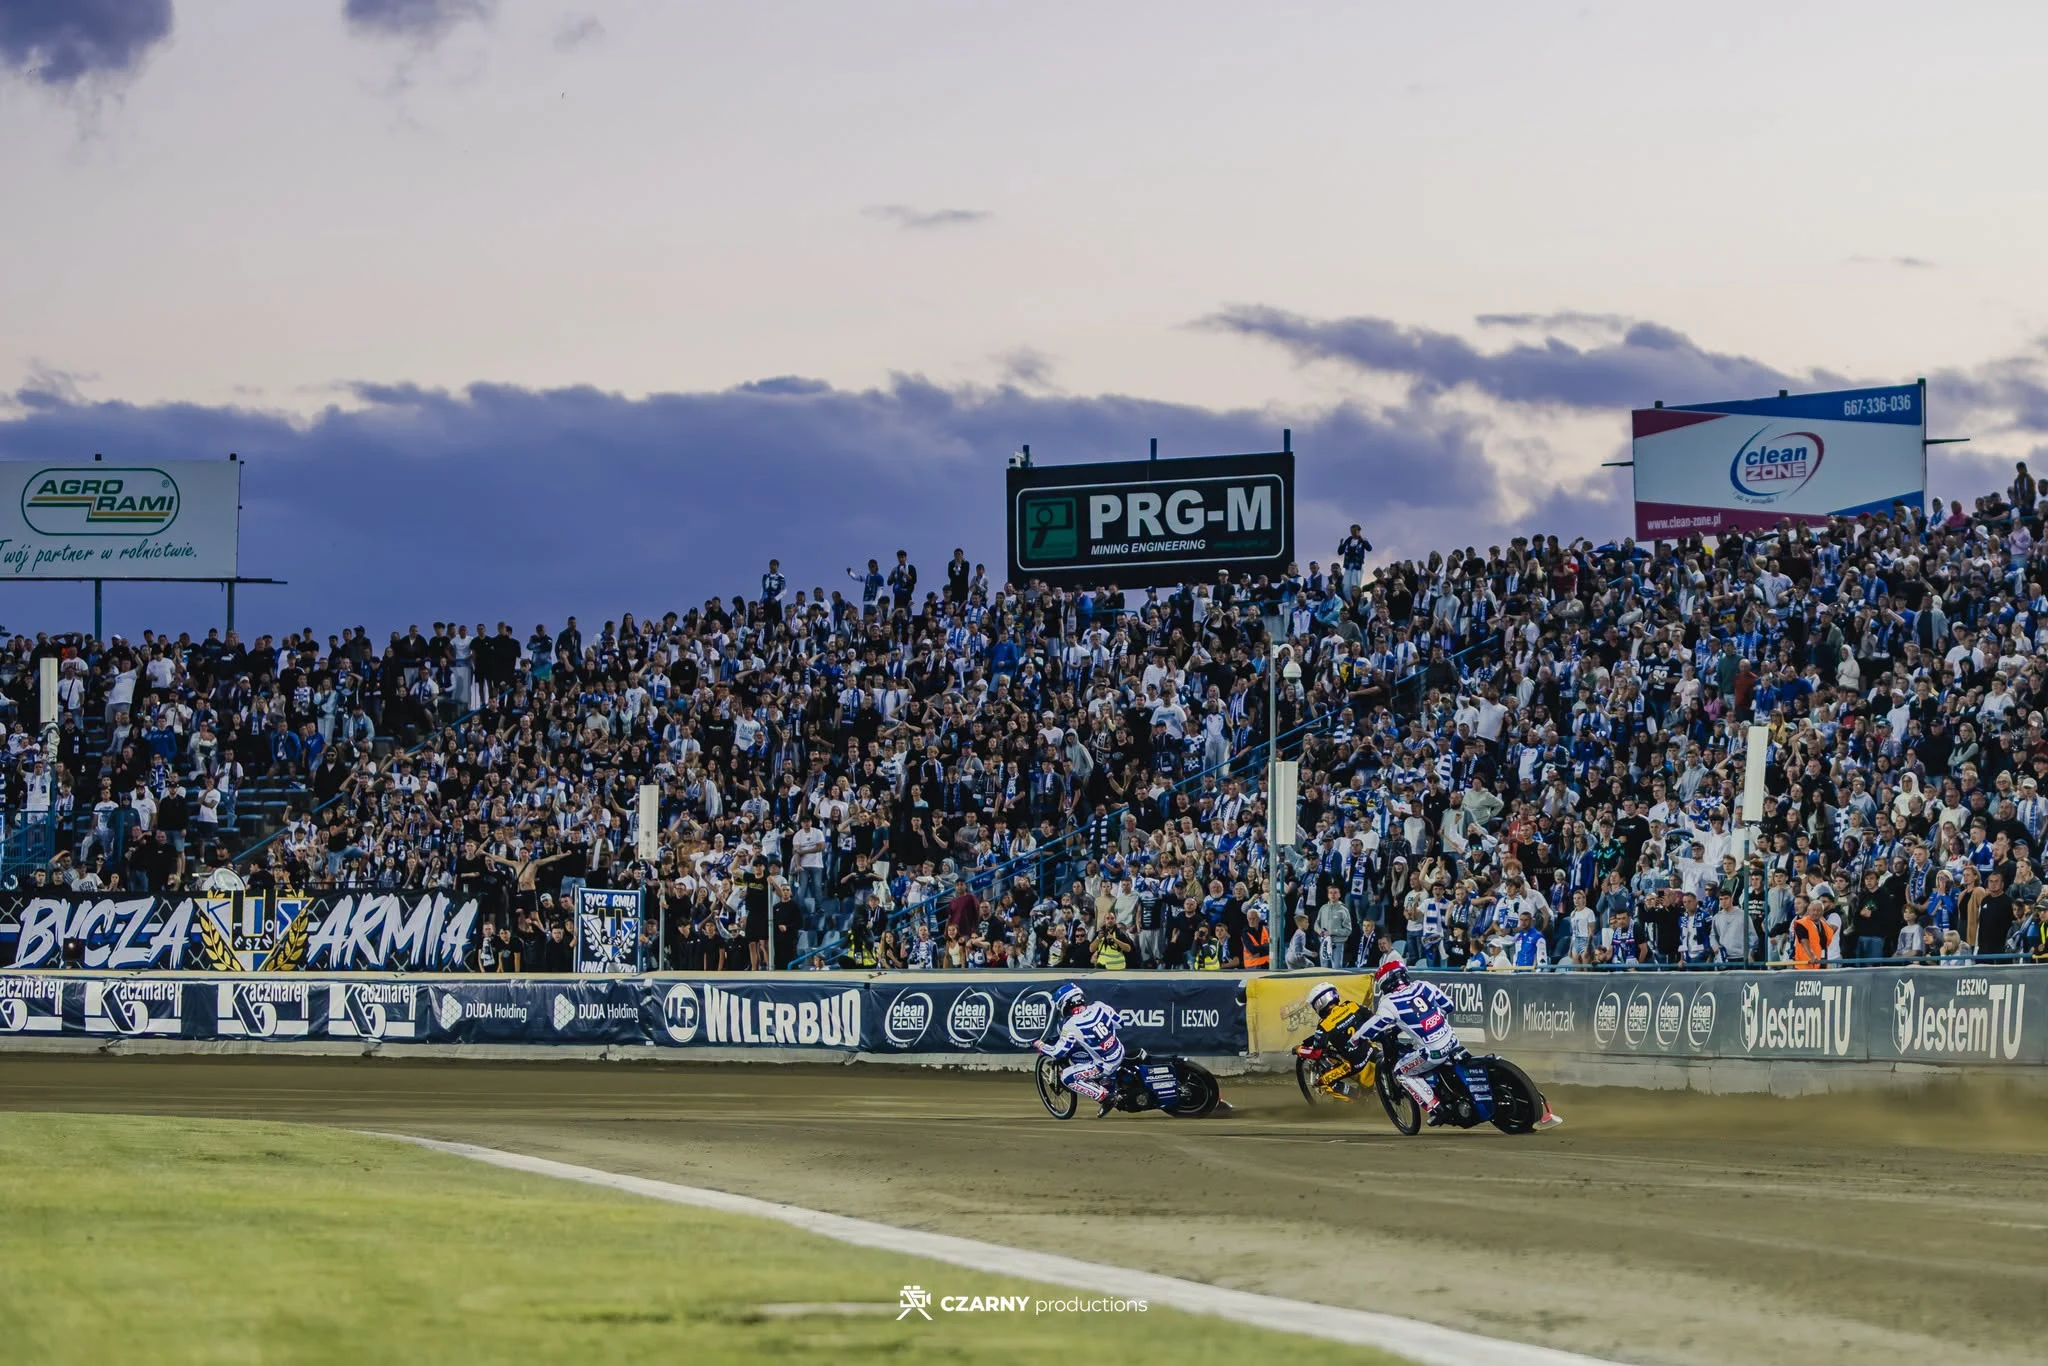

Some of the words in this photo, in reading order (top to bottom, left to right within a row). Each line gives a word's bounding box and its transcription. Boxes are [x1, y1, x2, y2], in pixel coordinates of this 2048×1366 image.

[1844, 395, 1911, 416] 667-336-036
[1745, 446, 1807, 466] clean
[1745, 462, 1806, 481] ZONE
[37, 480, 124, 494] AGRO
[97, 496, 175, 511] RAMI
[1090, 486, 1272, 539] PRG-M
[1647, 512, 1722, 530] www.clean-zone.pl
[1091, 543, 1129, 555] MINING
[1131, 539, 1206, 554] ENGINEERING
[32, 545, 94, 572] partner
[101, 548, 113, 560] w
[612, 895, 636, 907] RMIA
[307, 892, 478, 969] ARMIA
[1795, 980, 1821, 996] LESZNO
[1956, 978, 1988, 996] LESZNO
[0, 979, 62, 1016] aczmarek
[1414, 997, 1428, 1012] 9
[466, 1003, 493, 1019] DUDA
[495, 1002, 527, 1023] Holding
[580, 1003, 605, 1019] DUDA
[607, 1002, 639, 1023] Holding
[704, 983, 860, 1046] WILERBUD
[892, 1002, 925, 1017] clean
[955, 1001, 986, 1016] clean
[1015, 1001, 1046, 1016] clean
[1598, 1001, 1616, 1017] clean
[1629, 1001, 1647, 1017] clean
[1660, 1001, 1679, 1017] clean
[1692, 1001, 1711, 1017] clean
[892, 1017, 924, 1030] ZONE
[954, 1016, 985, 1030] ZONE
[1015, 1016, 1046, 1030] ZONE
[1119, 1009, 1164, 1027] EXUS
[1181, 1009, 1219, 1027] LESZNO
[1523, 1002, 1575, 1039] Mikołajczak
[1759, 986, 1853, 1056] JestemTU
[1914, 984, 2025, 1060] JestemTU
[1093, 1021, 1109, 1038] 16
